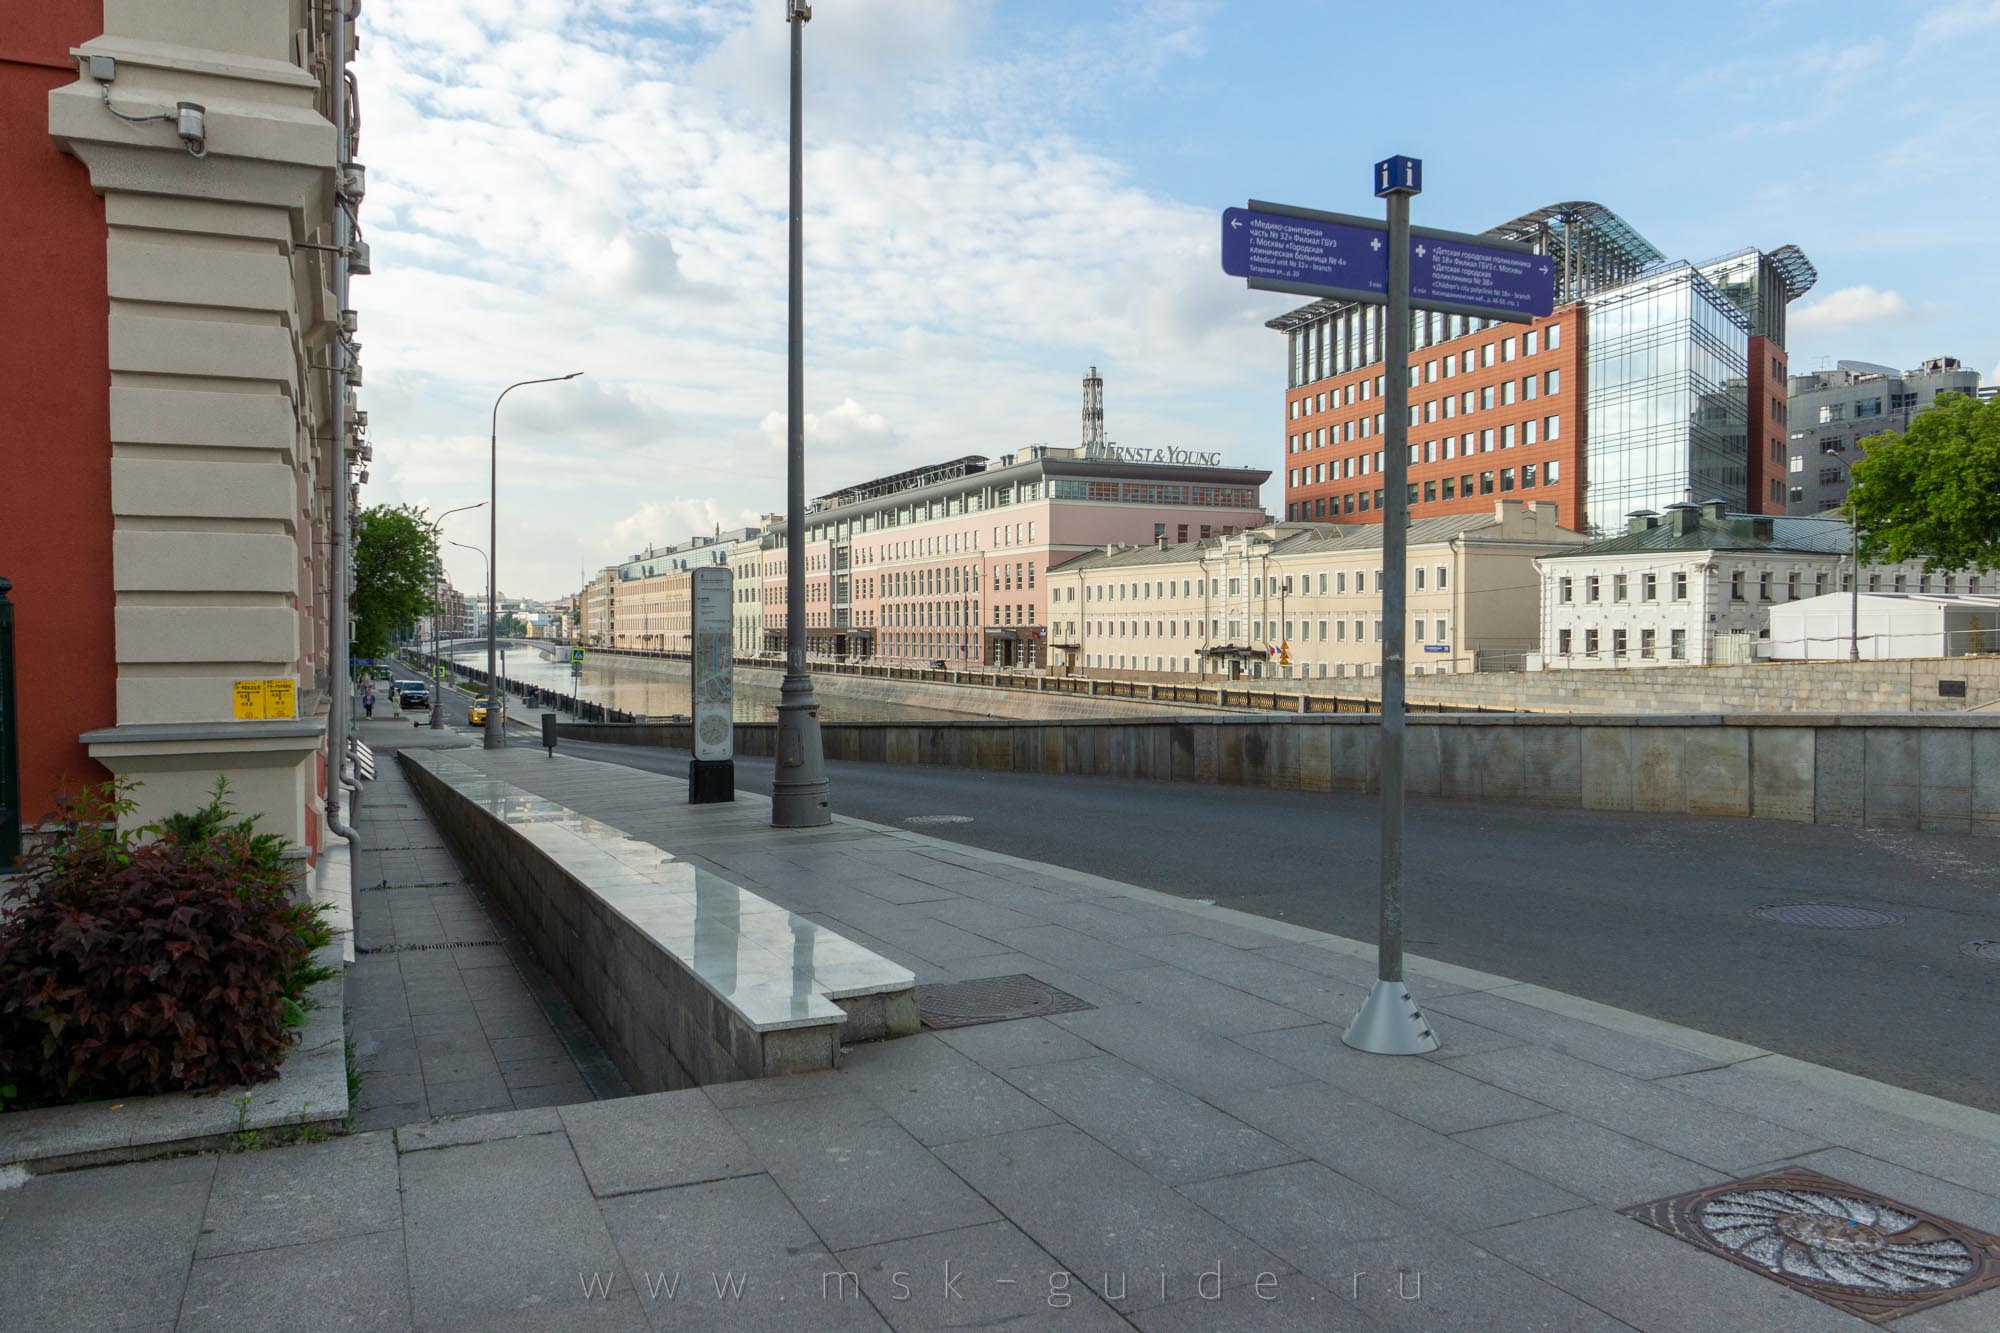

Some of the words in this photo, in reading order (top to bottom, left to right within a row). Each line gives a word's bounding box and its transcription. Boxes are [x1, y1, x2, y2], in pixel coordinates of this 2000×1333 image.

[1250, 219, 1323, 236] «Медико-санитарная
[1250, 229, 1268, 238] часть
[1270, 232, 1278, 240] №
[1280, 232, 1292, 240] 32»
[1294, 235, 1319, 244] Филиал
[1321, 238, 1336, 247] ГБУЗ
[1257, 238, 1284, 248] Москвы
[1286, 242, 1323, 253] «Городская
[1250, 248, 1293, 258] клиническая
[1295, 252, 1327, 263] больница
[1433, 247, 1460, 256] «Детская
[1462, 252, 1491, 262] городская
[1493, 256, 1531, 268] поликлиника
[1250, 256, 1275, 264] «Medical
[1313, 263, 1332, 272] branch
[1433, 264, 1460, 273] «Детская
[1462, 268, 1491, 278] городская
[1442, 256, 1452, 264] 18»
[1454, 258, 1477, 268] Филиал
[1479, 261, 1493, 270] ГБУЗ
[1499, 265, 1523, 275] Москвы
[1432, 273, 1472, 284] поликлиника
[1483, 278, 1493, 286] 38»
[1154, 449, 1165, 462] &
[1168, 446, 1221, 466] YOUNG
